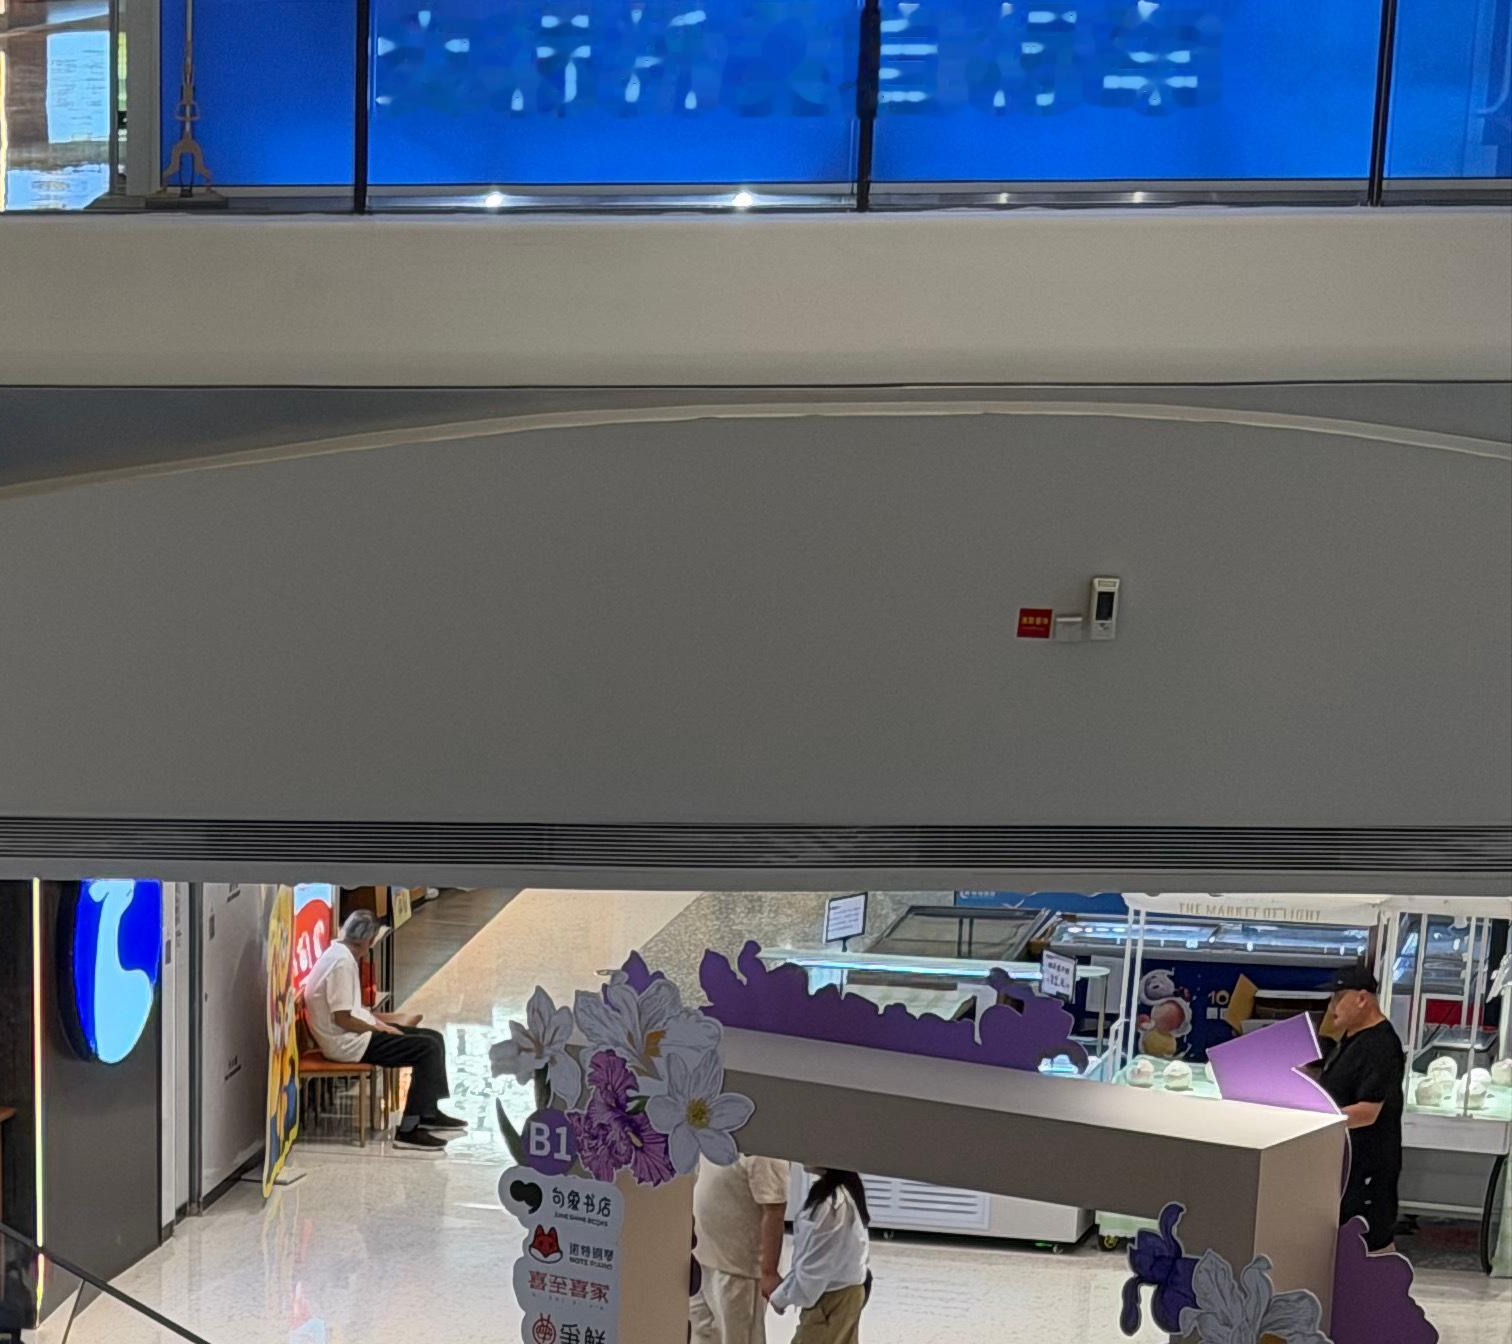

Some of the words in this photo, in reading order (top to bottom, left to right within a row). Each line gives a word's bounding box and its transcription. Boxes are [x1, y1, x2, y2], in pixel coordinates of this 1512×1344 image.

[1179, 902, 1201, 915] THE
[1206, 903, 1258, 918] MARKET
[529, 1121, 572, 1162] B1
